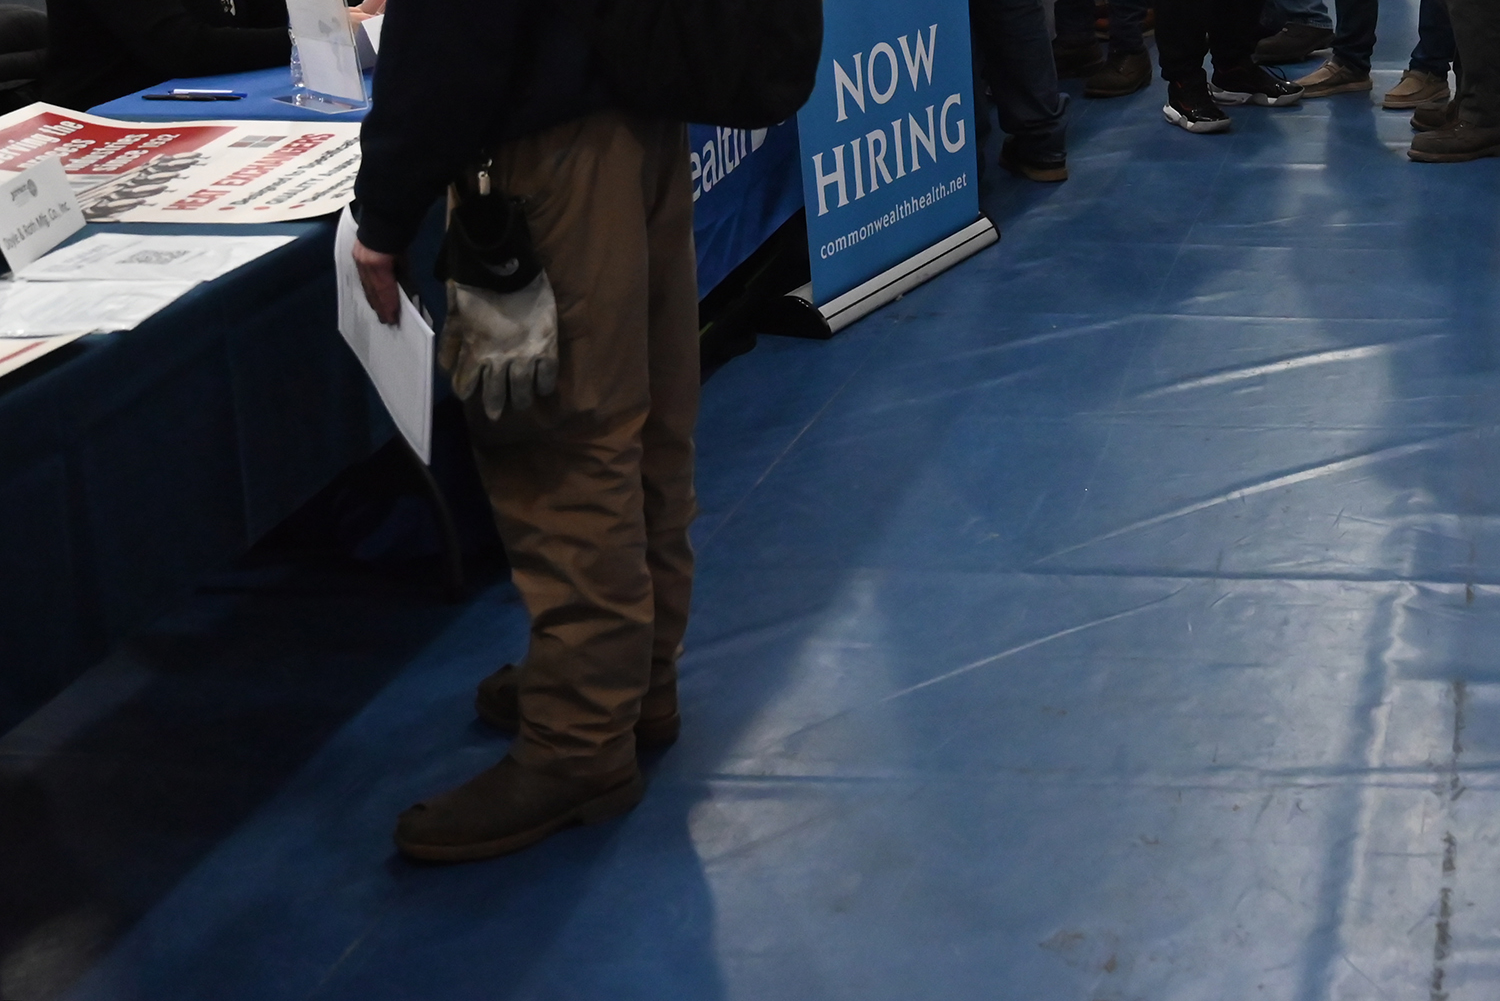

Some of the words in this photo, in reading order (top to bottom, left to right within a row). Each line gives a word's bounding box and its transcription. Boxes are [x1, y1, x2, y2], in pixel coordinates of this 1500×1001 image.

[832, 23, 938, 123] NOW
[38, 120, 84, 136] the
[812, 93, 966, 217] HIRING
[162, 188, 232, 211] HEAT
[211, 133, 336, 187] EXCHANGERS
[819, 173, 968, 260] commonwealthhealth.net
